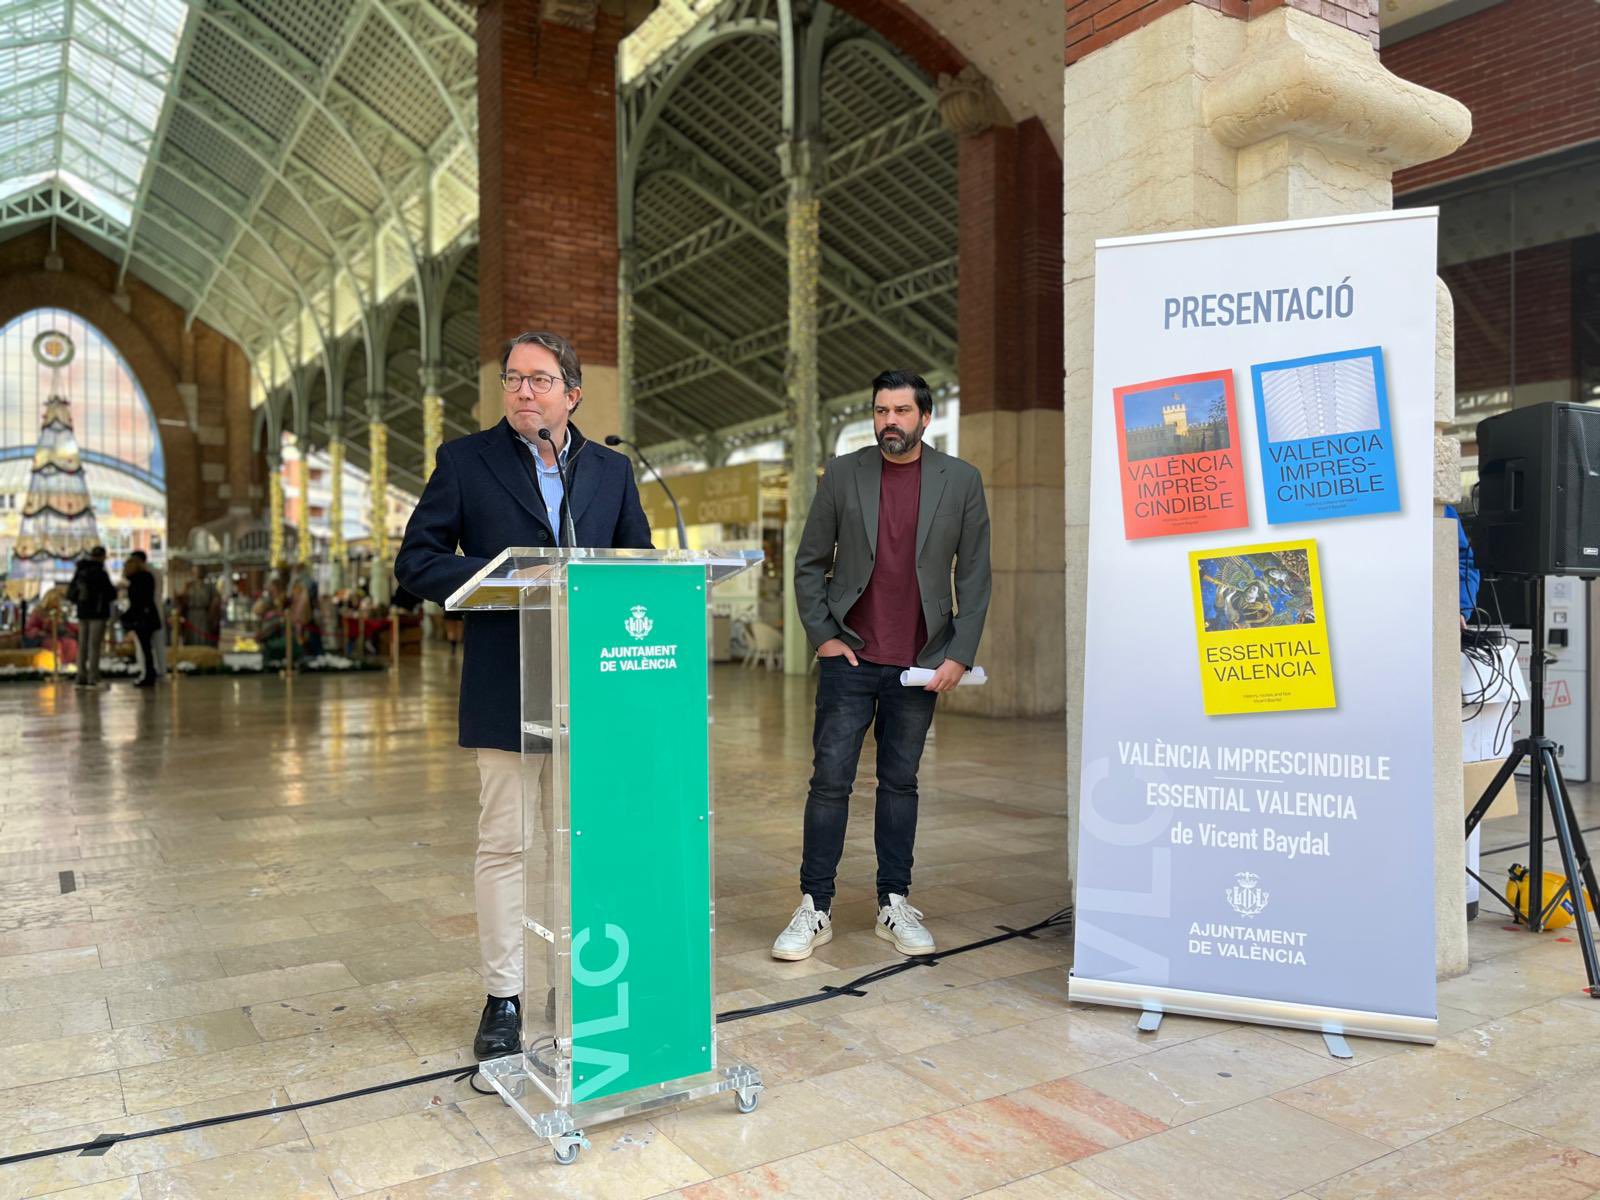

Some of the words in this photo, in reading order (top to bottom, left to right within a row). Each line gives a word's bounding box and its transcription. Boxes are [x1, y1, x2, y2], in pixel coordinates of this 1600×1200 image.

[1164, 276, 1354, 330] PRESENTACIÓ
[1269, 434, 1383, 463] VALENCIA
[1280, 456, 1376, 482] IMPRES-
[1138, 475, 1226, 499] IMPRES-
[1277, 474, 1384, 502] CINDIBLE
[1135, 492, 1234, 518] CINDIBLE
[600, 645, 677, 658] AJUNTAMENT
[600, 661, 617, 672] DE
[619, 657, 677, 671] VALÈNCIA
[1206, 640, 1320, 663] ESSENTIAL
[1213, 661, 1316, 682] VALENCIA
[1118, 739, 1211, 770] VALÈNCIA
[1217, 747, 1391, 781] IMPRESCINDIBLE
[1146, 782, 1250, 813] ESSENTIAL
[1256, 789, 1358, 820] VALENCIA
[1171, 822, 1193, 845] de
[1199, 823, 1258, 850] Vicent
[1263, 828, 1330, 859] Baydal
[1189, 922, 1307, 946] AJUNTAMENT
[1188, 940, 1212, 955] DE
[1217, 942, 1307, 966] VALÈNCIA
[571, 923, 630, 1105] VLC
